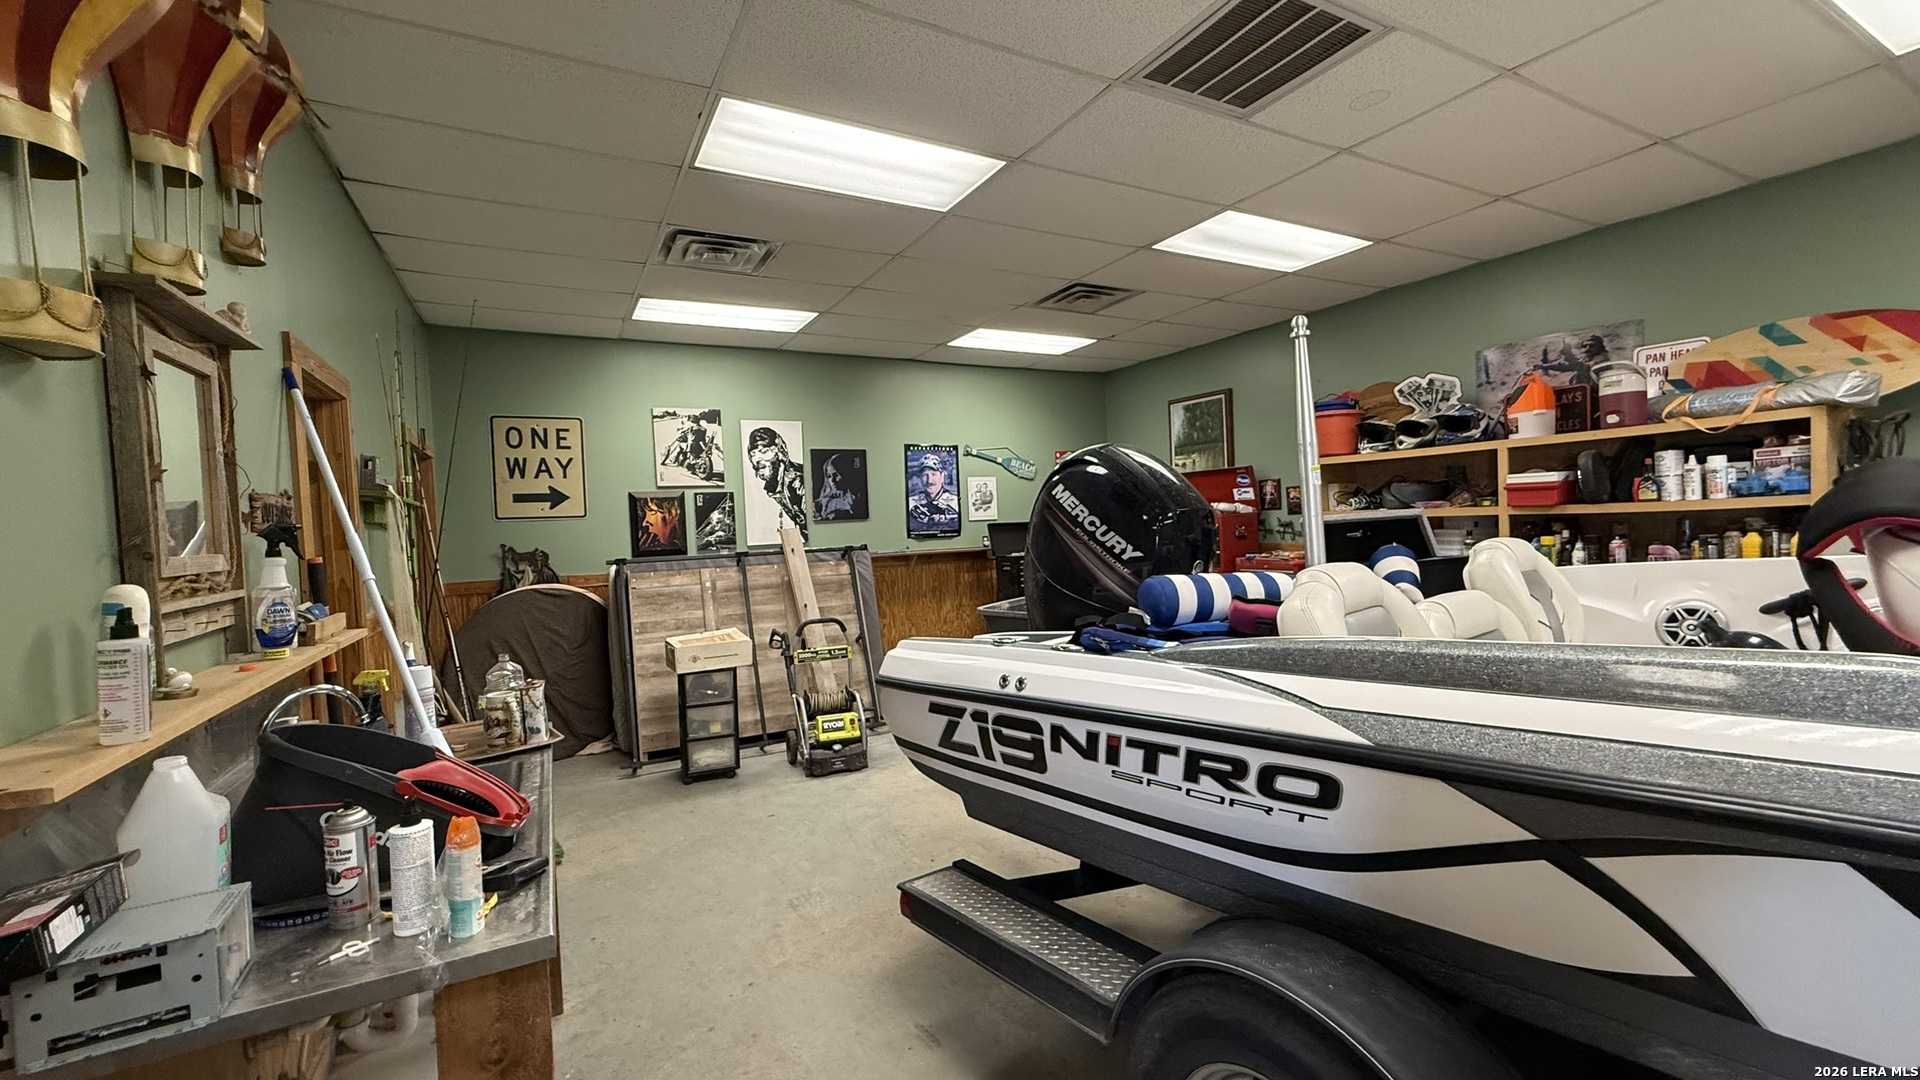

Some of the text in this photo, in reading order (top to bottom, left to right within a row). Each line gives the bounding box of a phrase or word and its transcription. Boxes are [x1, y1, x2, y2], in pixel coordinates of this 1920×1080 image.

[1645, 348, 1696, 364] PAN HE
[505, 426, 572, 450] ONE
[505, 457, 574, 480] WAY
[1051, 483, 1144, 561] MERCURY
[267, 607, 291, 615] DAWN
[928, 701, 1344, 812] Z19 NITRO
[1110, 768, 1329, 823] SPORT
[335, 849, 353, 857] Flow
